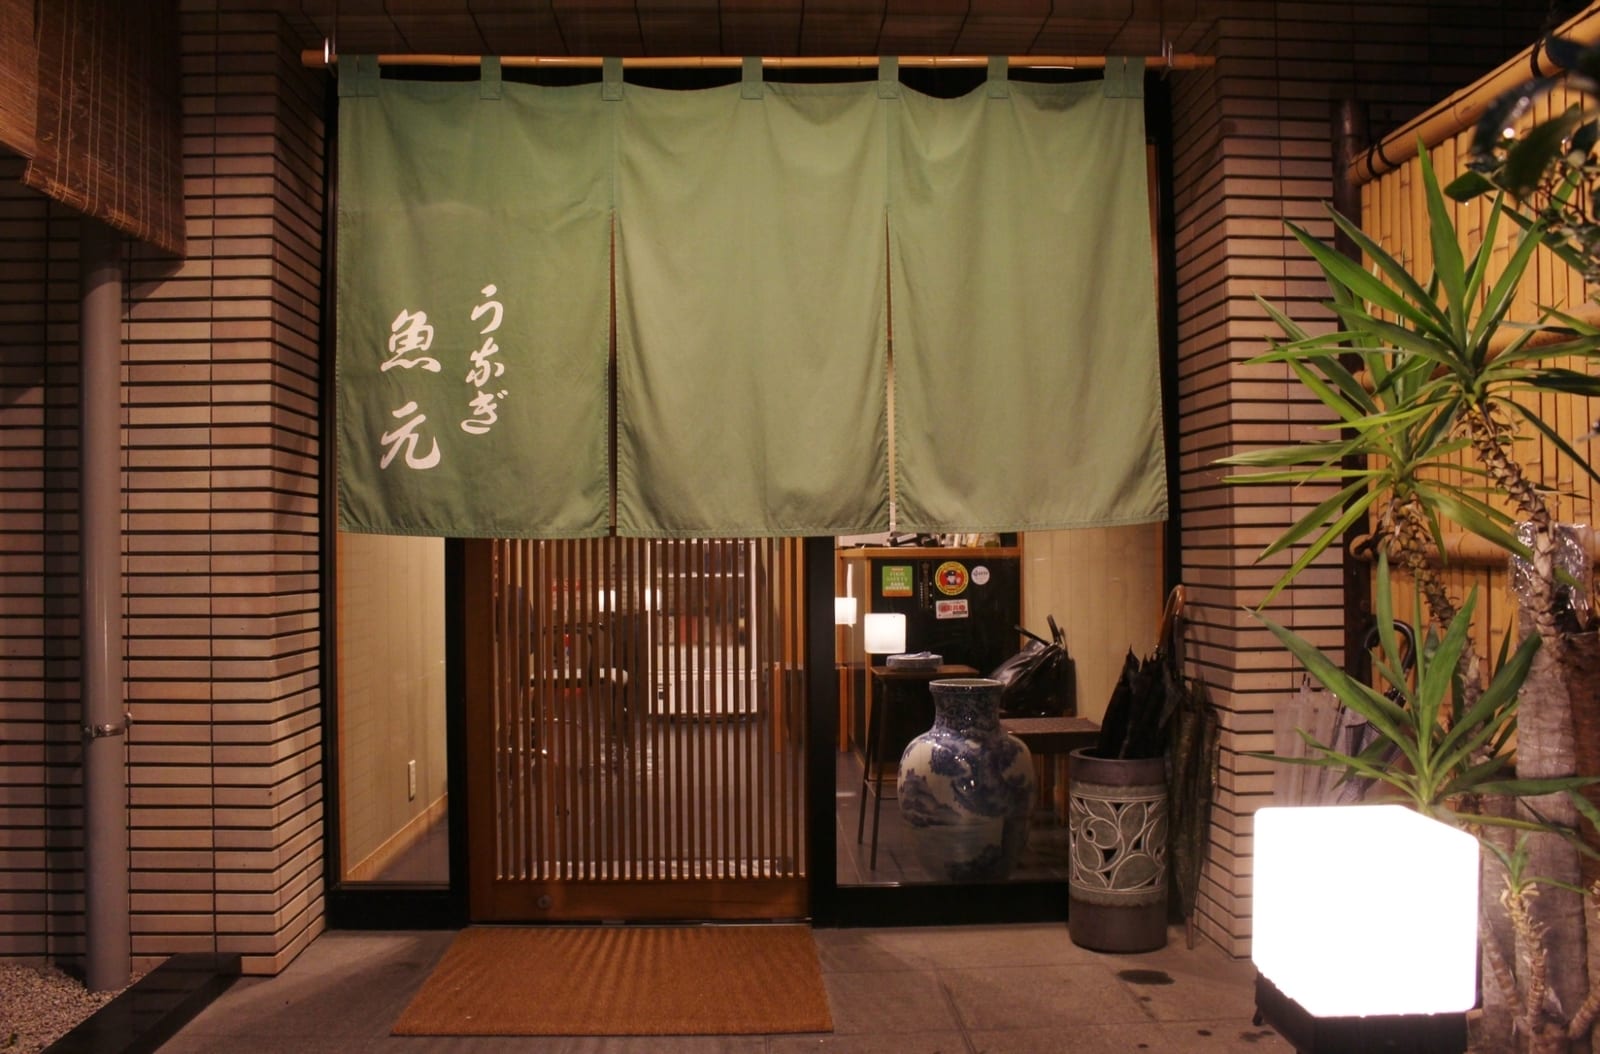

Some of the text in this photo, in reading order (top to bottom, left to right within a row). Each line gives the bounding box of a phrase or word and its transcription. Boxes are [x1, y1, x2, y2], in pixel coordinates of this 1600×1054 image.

[380, 308, 441, 470] 魚元
[460, 283, 508, 435] うなぎ
